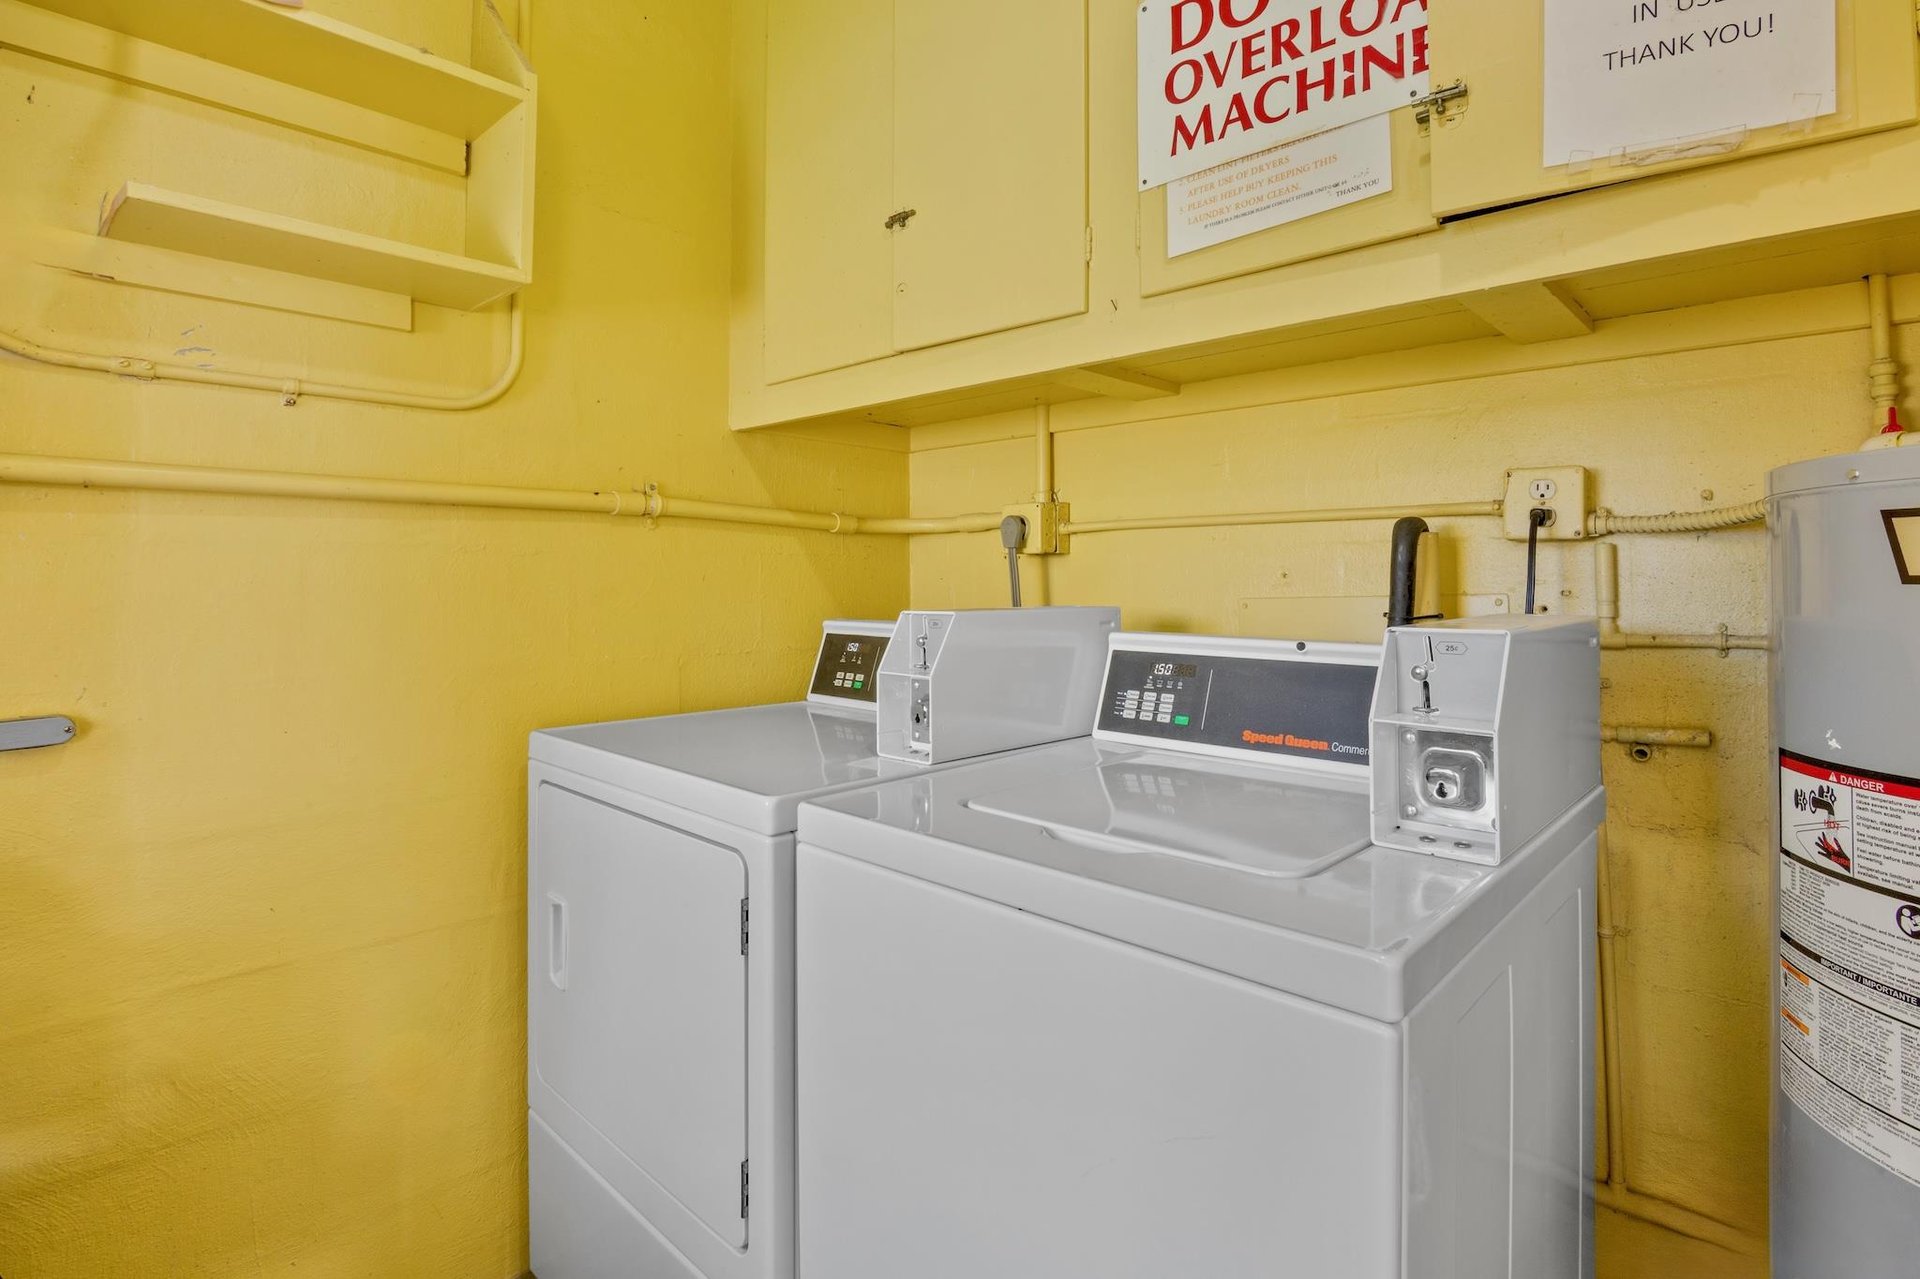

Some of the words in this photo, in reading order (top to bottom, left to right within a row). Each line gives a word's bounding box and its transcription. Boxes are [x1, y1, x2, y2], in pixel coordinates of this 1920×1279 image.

[1633, 0, 1658, 23] IN
[1602, 33, 1695, 71] THANK
[1703, 13, 1775, 48] YOU!
[1170, 25, 1430, 158] MACHINE
[1187, 195, 1217, 212] PLEASE
[1220, 184, 1244, 201] HELP
[1266, 162, 1311, 186] KEEPING
[1311, 153, 1339, 170] THIS
[1188, 181, 1216, 198] AFTER
[1217, 174, 1235, 187] USE
[1235, 169, 1250, 181] OF
[1250, 155, 1291, 178] DRYERS
[1335, 182, 1362, 198] THANK
[1361, 177, 1381, 190] YOU
[1187, 204, 1233, 226] LAUNDRY
[1234, 195, 1265, 212] ROOM
[1242, 729, 1284, 745] Speed
[1284, 734, 1329, 751] Queen
[1839, 775, 1885, 793] DANGER
[1820, 956, 1859, 983] IMPORTANT
[1861, 977, 1918, 1005] IMPORTANTE
